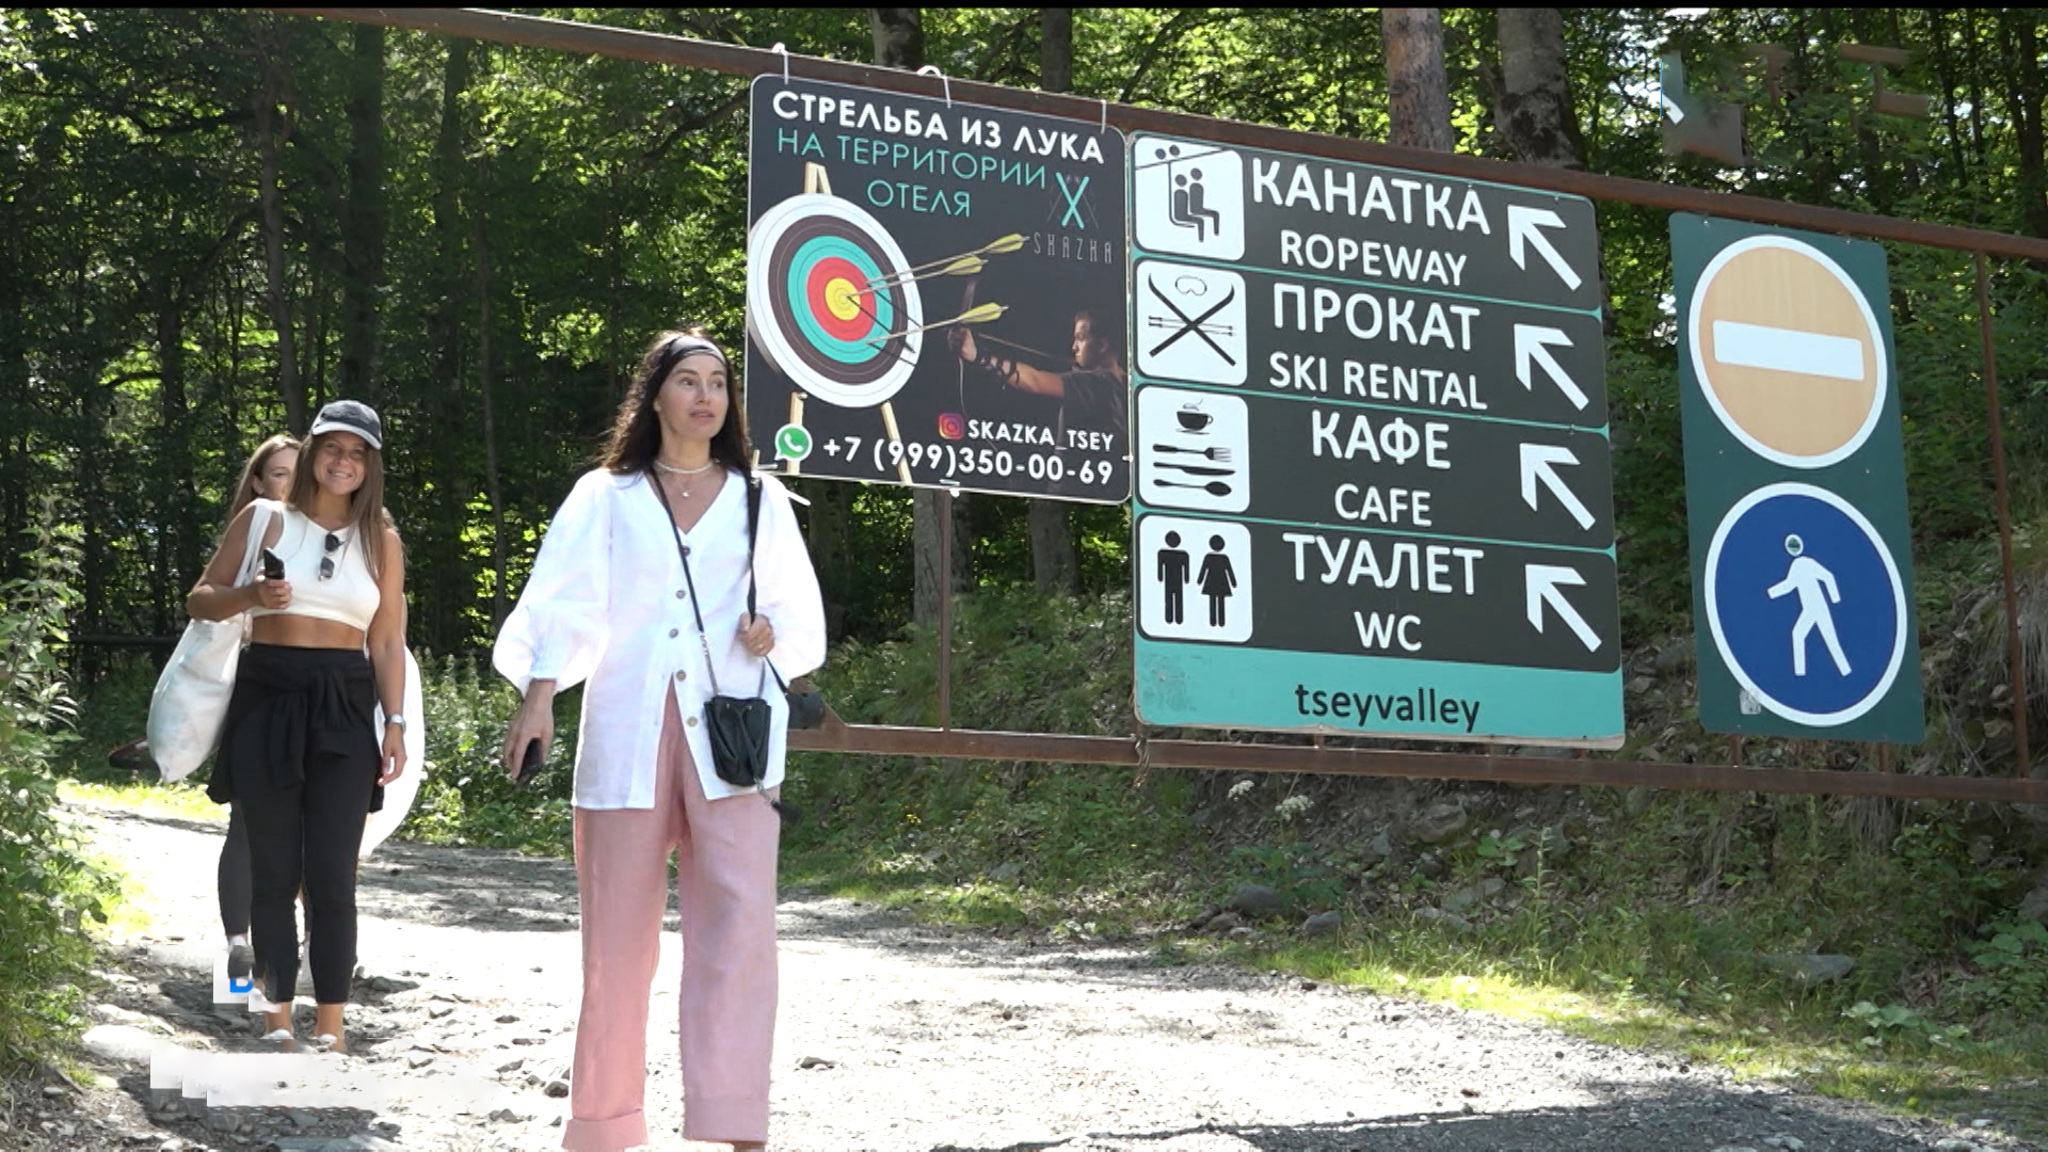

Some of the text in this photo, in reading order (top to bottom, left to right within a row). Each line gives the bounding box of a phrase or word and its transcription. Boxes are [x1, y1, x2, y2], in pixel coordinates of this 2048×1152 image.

[772, 90, 1104, 164] СТРЕЛЬБА ИЗ ЛУКА
[777, 127, 1046, 189] НА ТЕРРИТОРИИ
[867, 179, 970, 217] ОТЕЛЯ
[1252, 157, 1491, 235] КАНАТКА
[1280, 229, 1467, 287] ROPEWAY
[1273, 282, 1481, 351] ПРОКАТ
[1269, 351, 1488, 410] SKI RENTAL
[823, 436, 1113, 485] +7 (999)350-00-69
[968, 419, 1114, 452] SKAZKA_TSEY
[1311, 409, 1451, 469] КАФЕ
[1334, 483, 1432, 527] CAFE
[1282, 532, 1485, 595] ТУАЛЕТ
[1353, 610, 1422, 652] WC
[1294, 683, 1481, 733] tseyvalley
